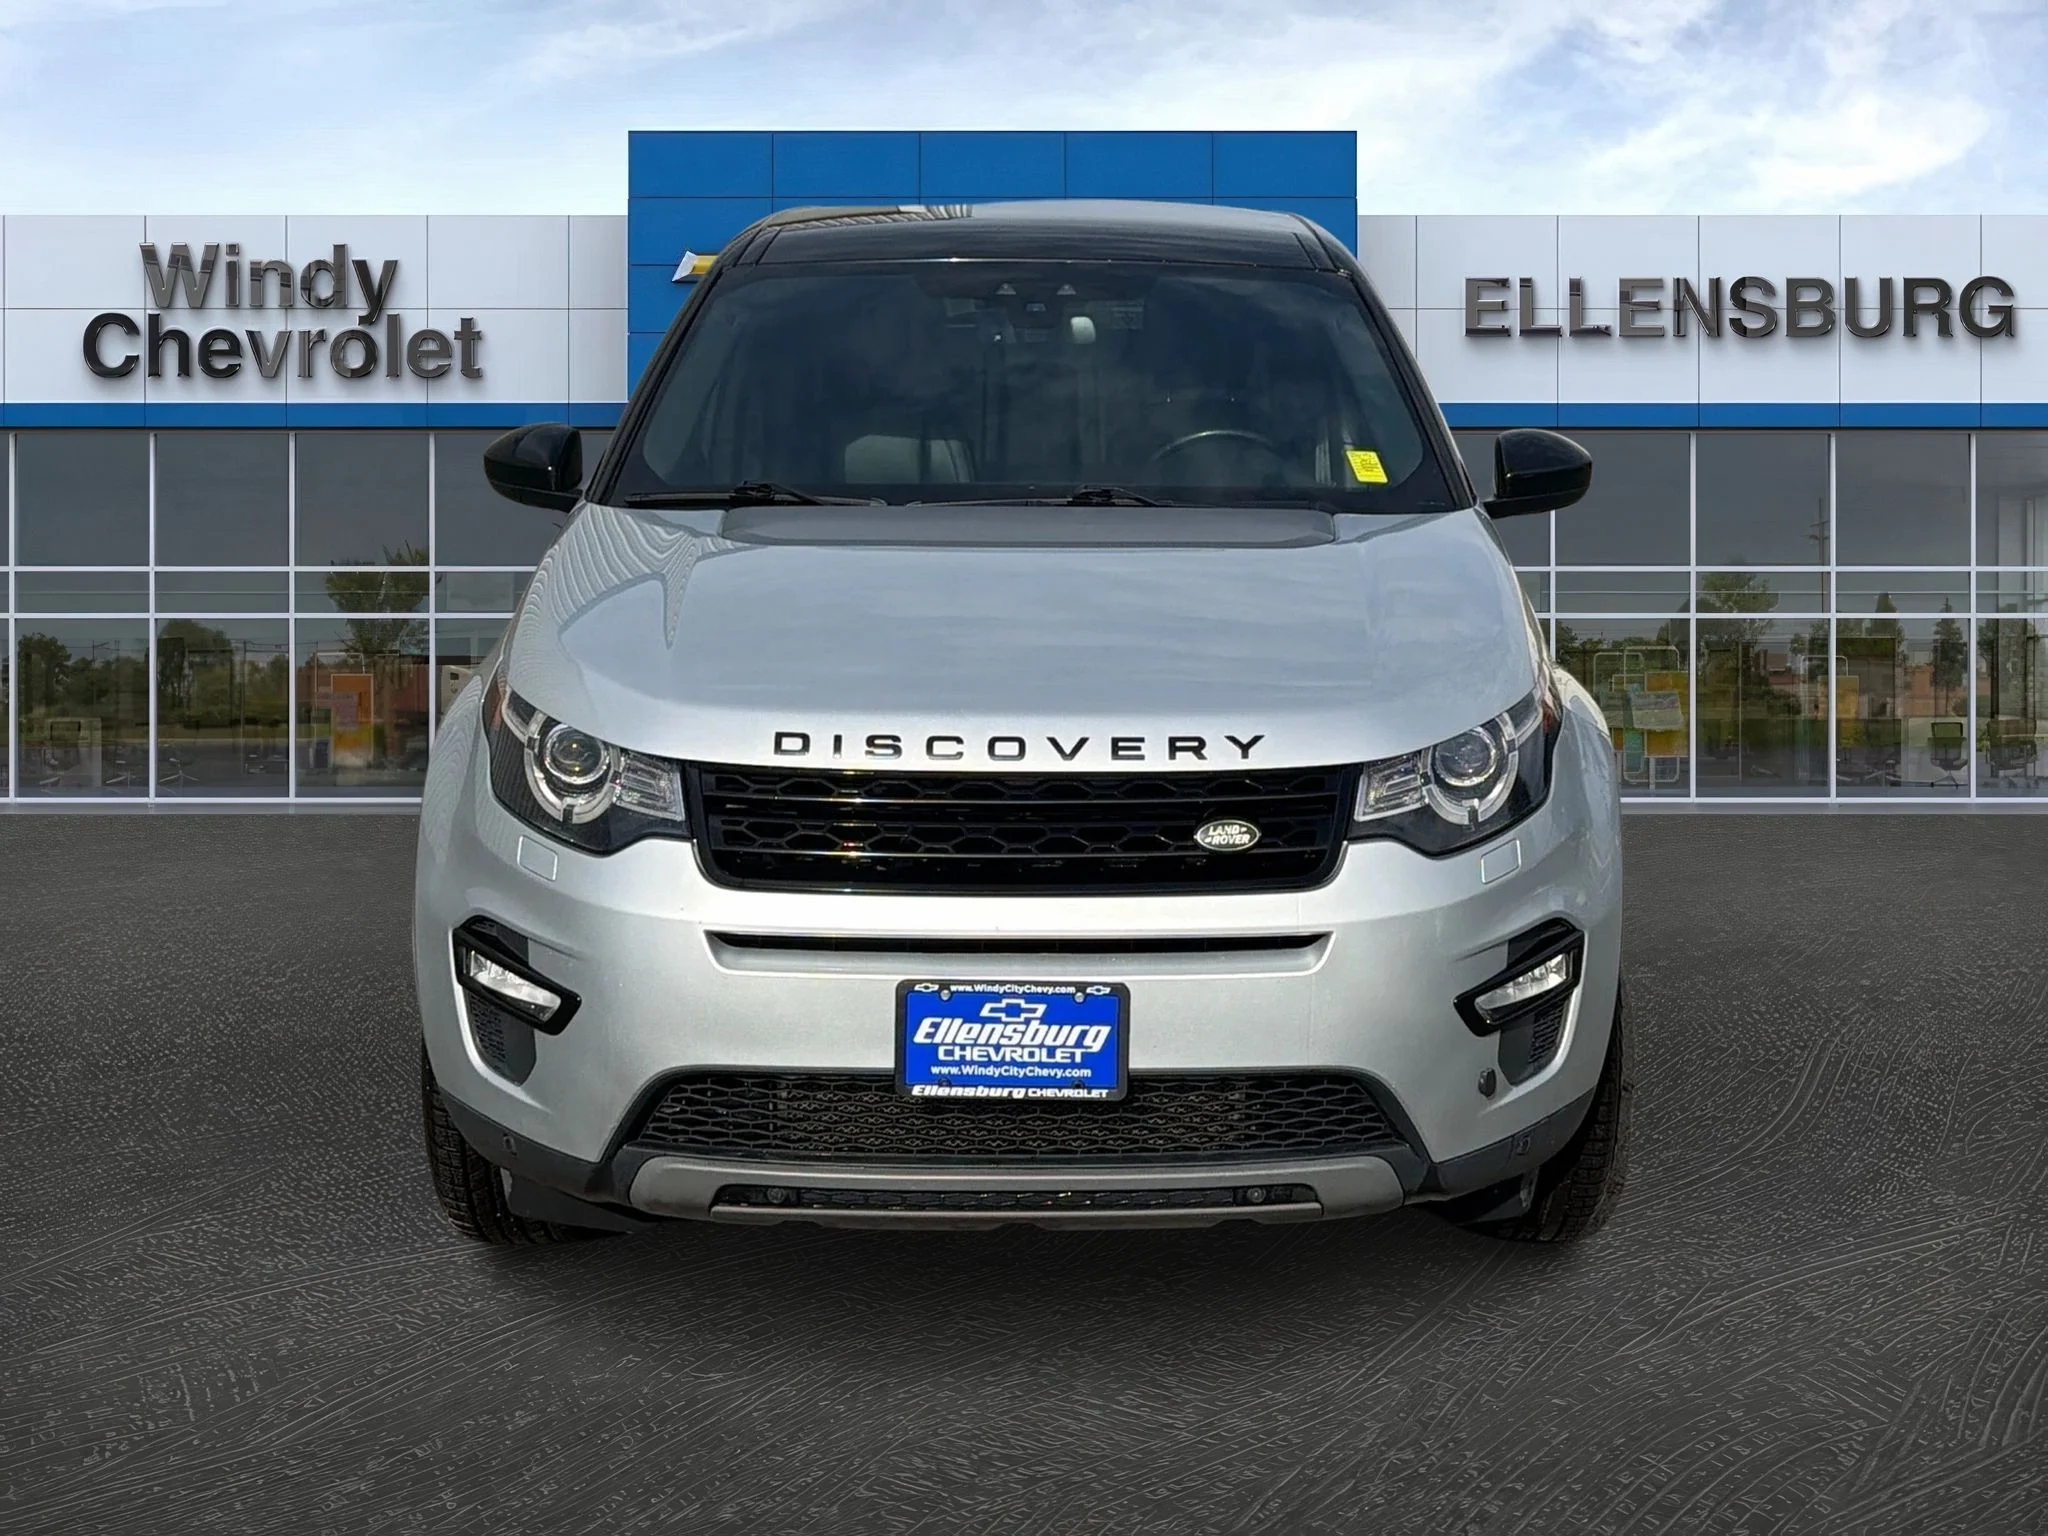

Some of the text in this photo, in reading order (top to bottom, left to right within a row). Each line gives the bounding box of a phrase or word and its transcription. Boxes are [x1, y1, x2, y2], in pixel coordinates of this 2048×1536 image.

[138, 242, 399, 325] Windy
[1464, 275, 2016, 338] ELLENSBURG
[82, 312, 484, 379] Chevrolet
[773, 731, 1265, 762] DISCOVERY
[1208, 825, 1240, 836] LAND
[1212, 834, 1250, 845] ROVER
[950, 984, 1076, 995] www.WindyCityChevy.com
[913, 1017, 1112, 1053] Ellensburg
[938, 1046, 1086, 1063] CHEVROLET
[930, 1065, 1092, 1078] www.WindyCityChevy.com
[911, 1085, 1108, 1099] Ellensburg CHEVROLET
